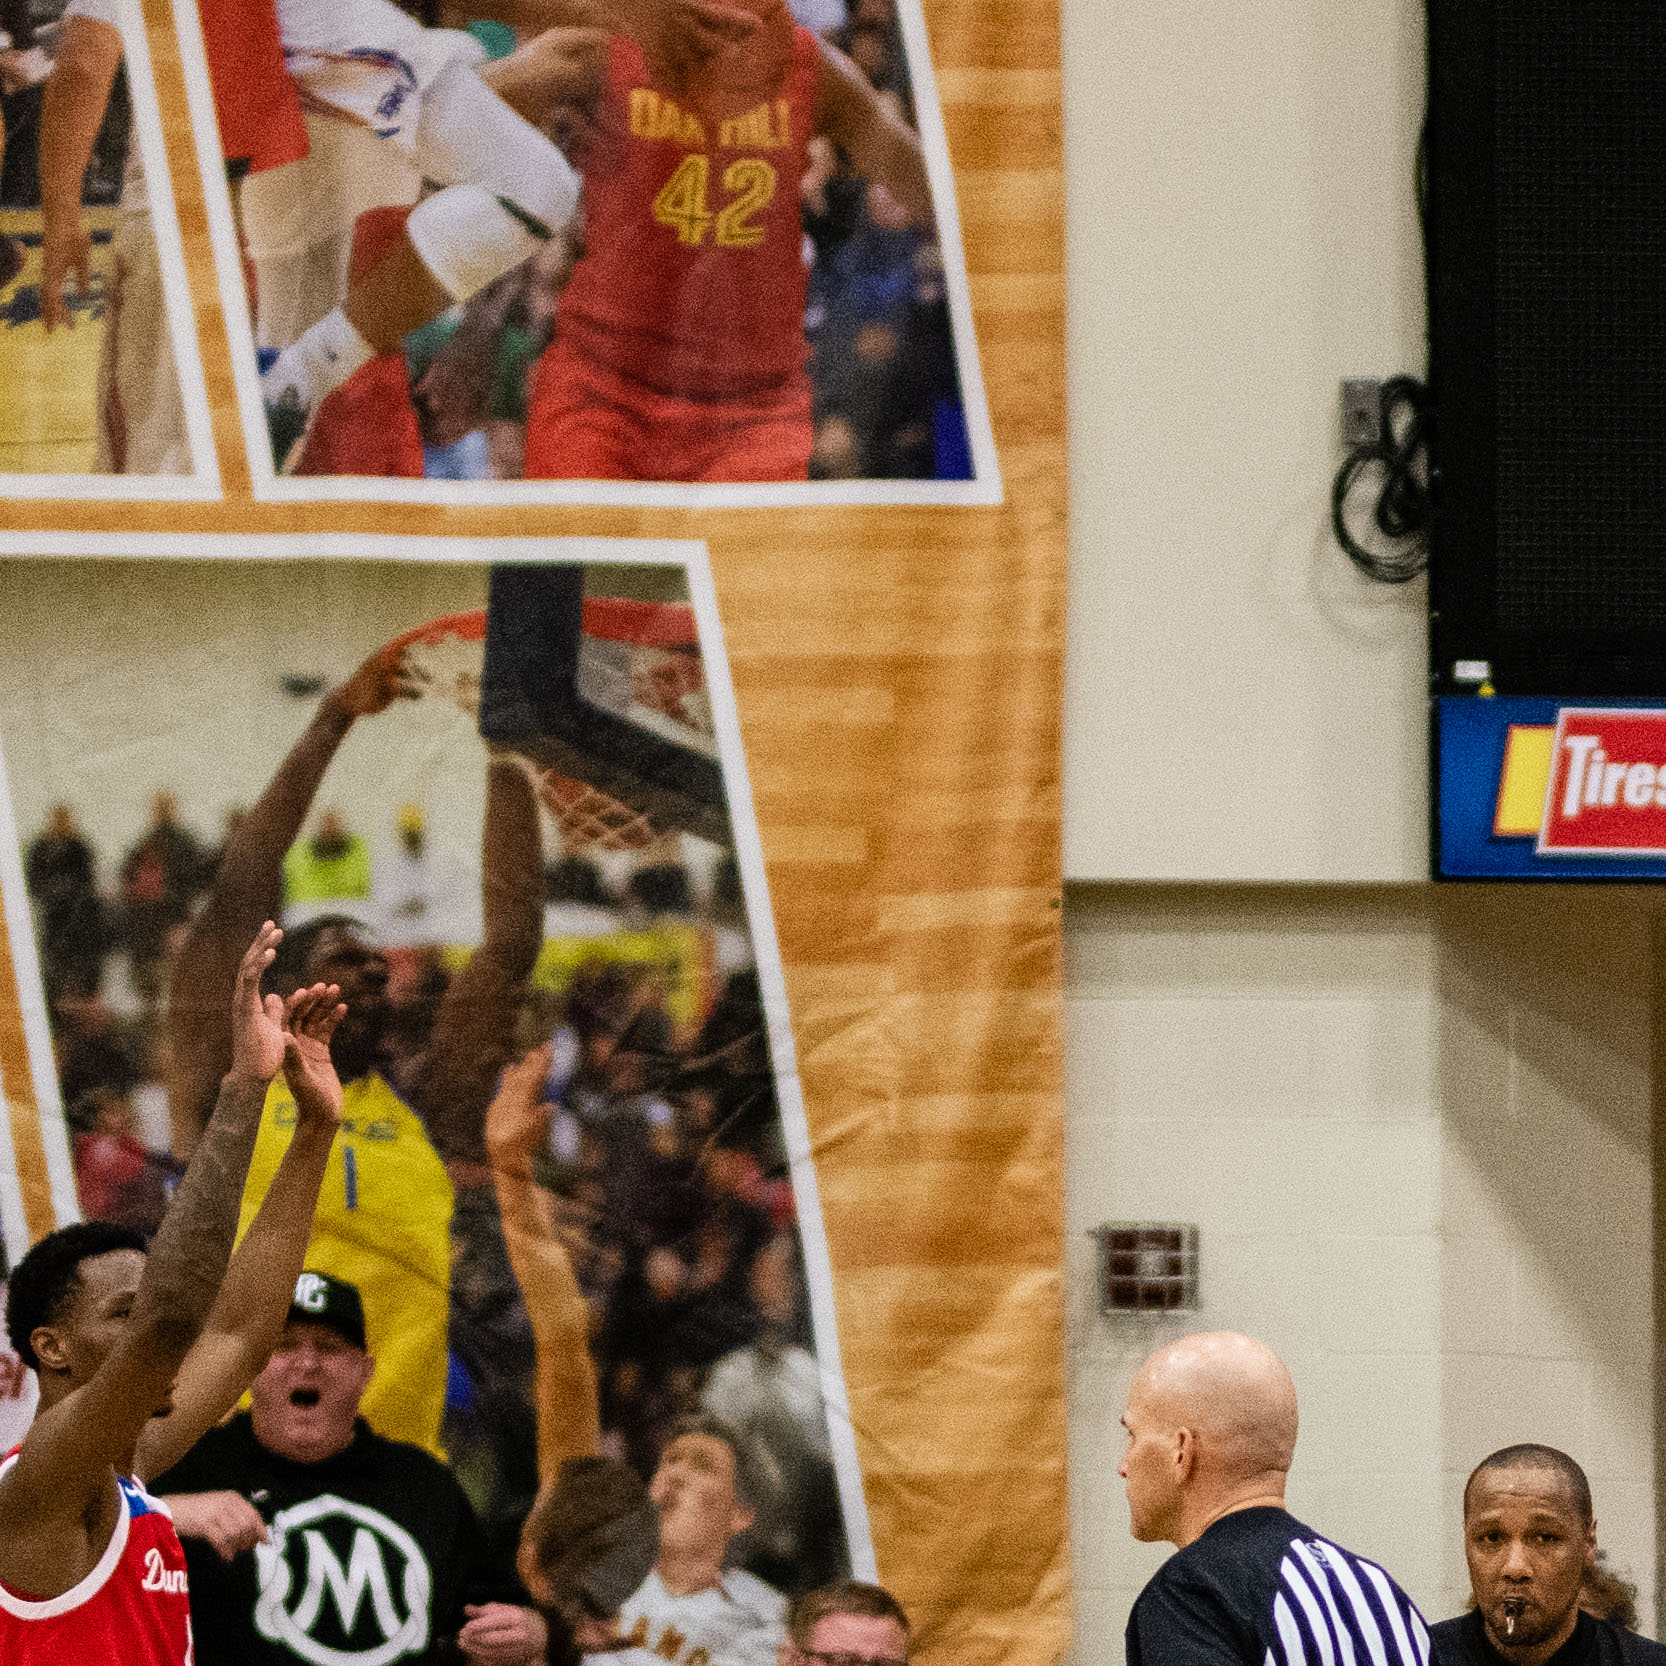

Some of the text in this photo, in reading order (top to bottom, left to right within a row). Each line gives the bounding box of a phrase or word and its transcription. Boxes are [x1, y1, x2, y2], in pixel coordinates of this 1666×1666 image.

[653, 153, 777, 247] 42
[141, 1547, 189, 1594] Dun
[291, 1527, 402, 1644] M
